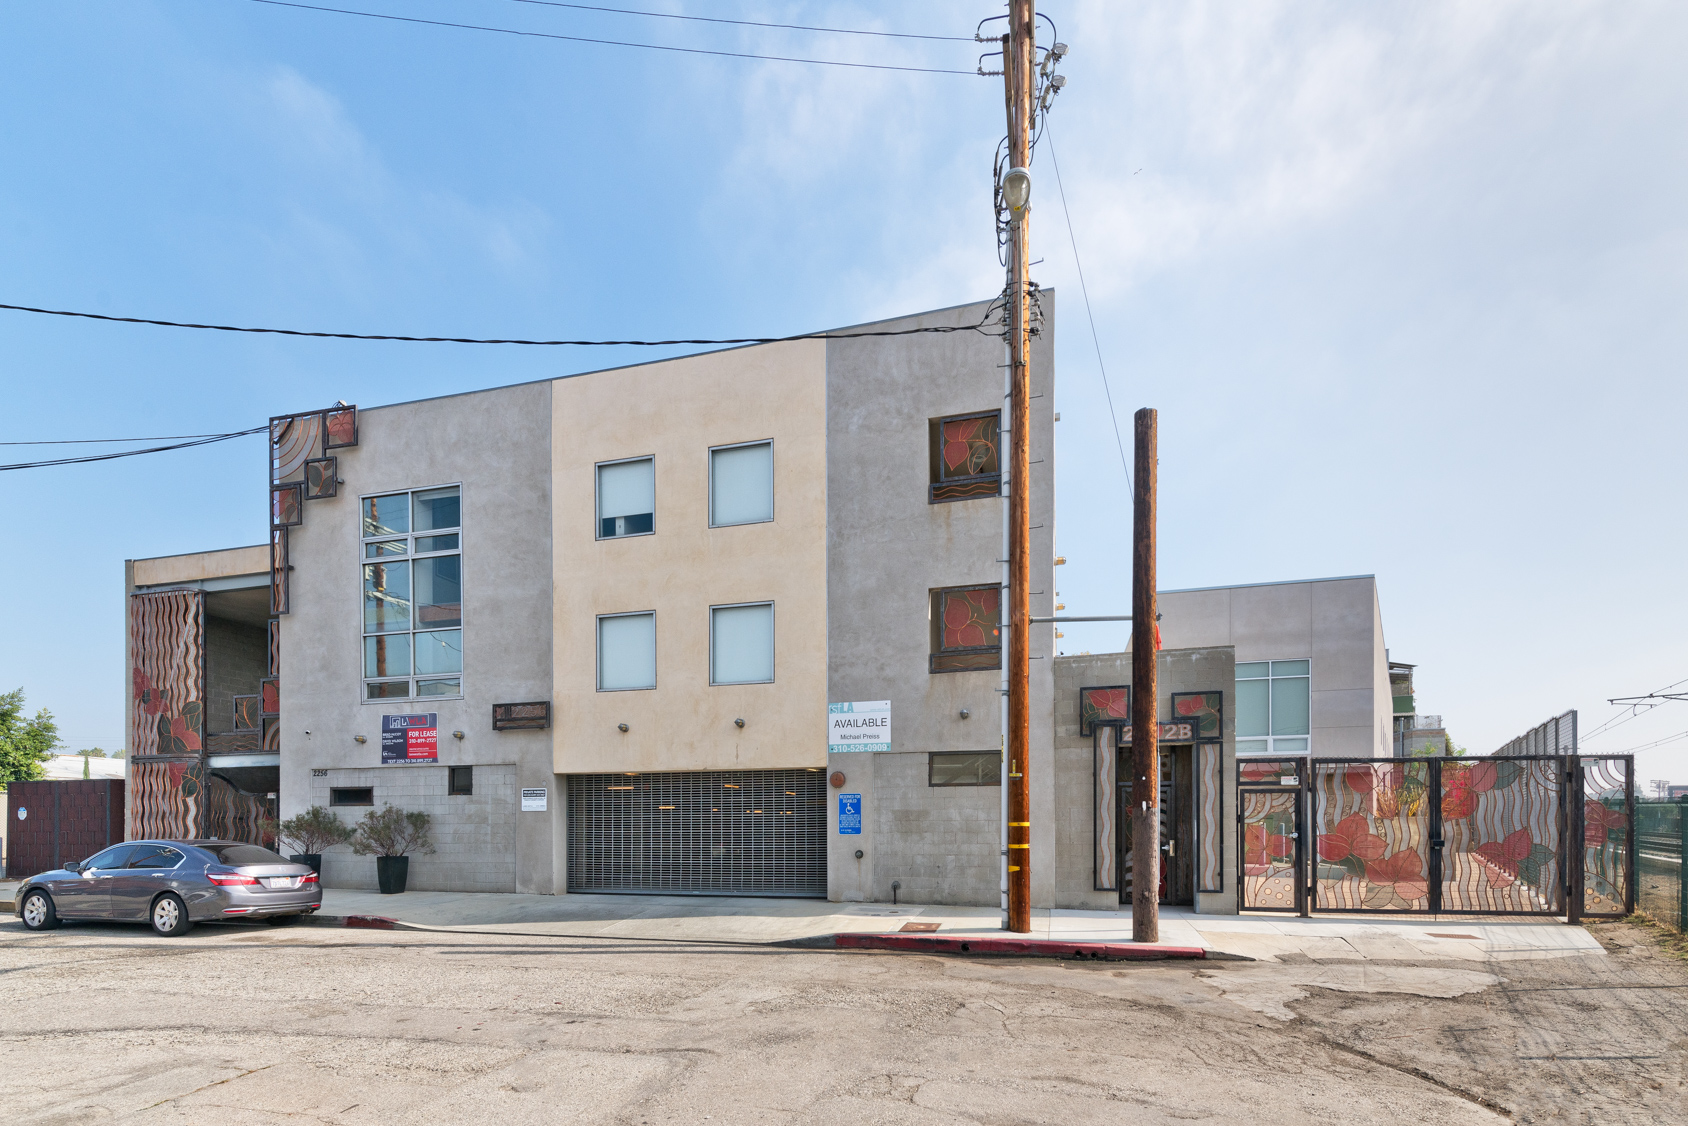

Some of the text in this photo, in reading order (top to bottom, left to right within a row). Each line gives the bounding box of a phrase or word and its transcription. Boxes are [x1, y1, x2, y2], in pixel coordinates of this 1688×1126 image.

[512, 704, 546, 718] 2256
[834, 718, 887, 728] AVAILABLE
[833, 744, 887, 752] 310-526-0909
